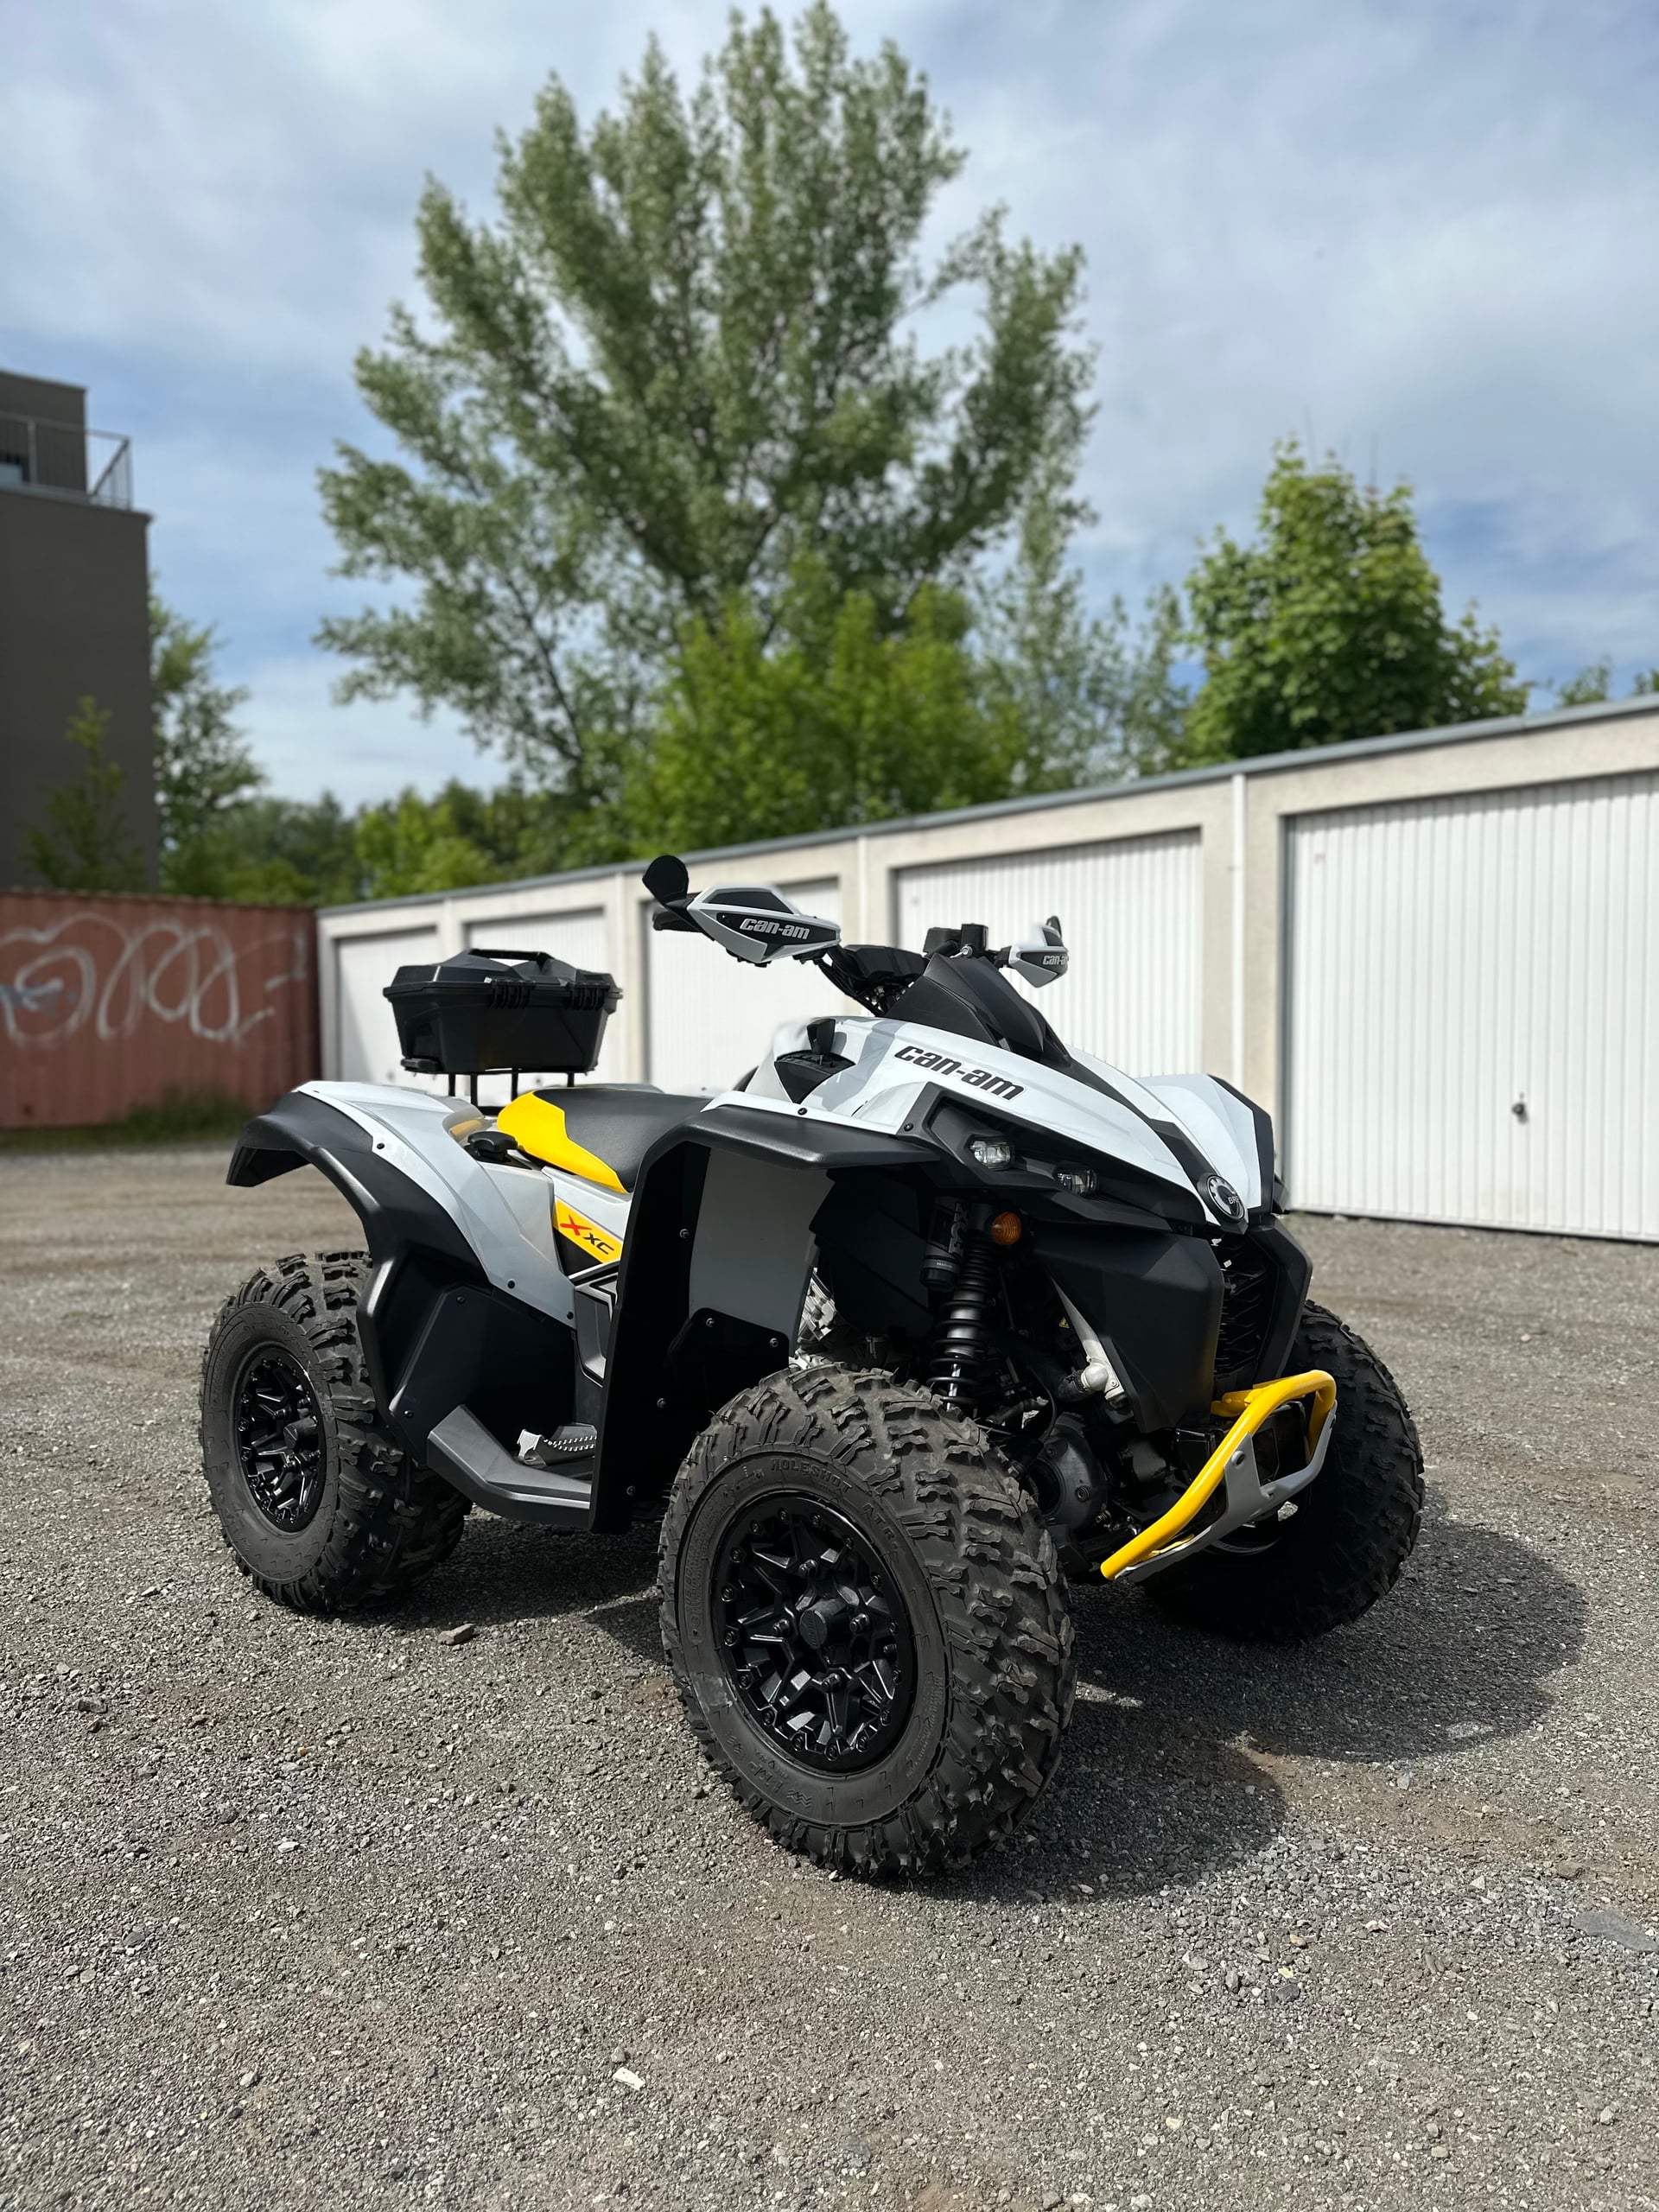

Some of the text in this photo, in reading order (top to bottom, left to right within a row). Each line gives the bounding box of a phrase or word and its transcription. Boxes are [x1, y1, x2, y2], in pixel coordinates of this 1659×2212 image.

[740, 918, 810, 940] can-am
[1042, 955, 1068, 965] can-a
[894, 1046, 1025, 1101] can-am
[560, 1215, 592, 1236] X
